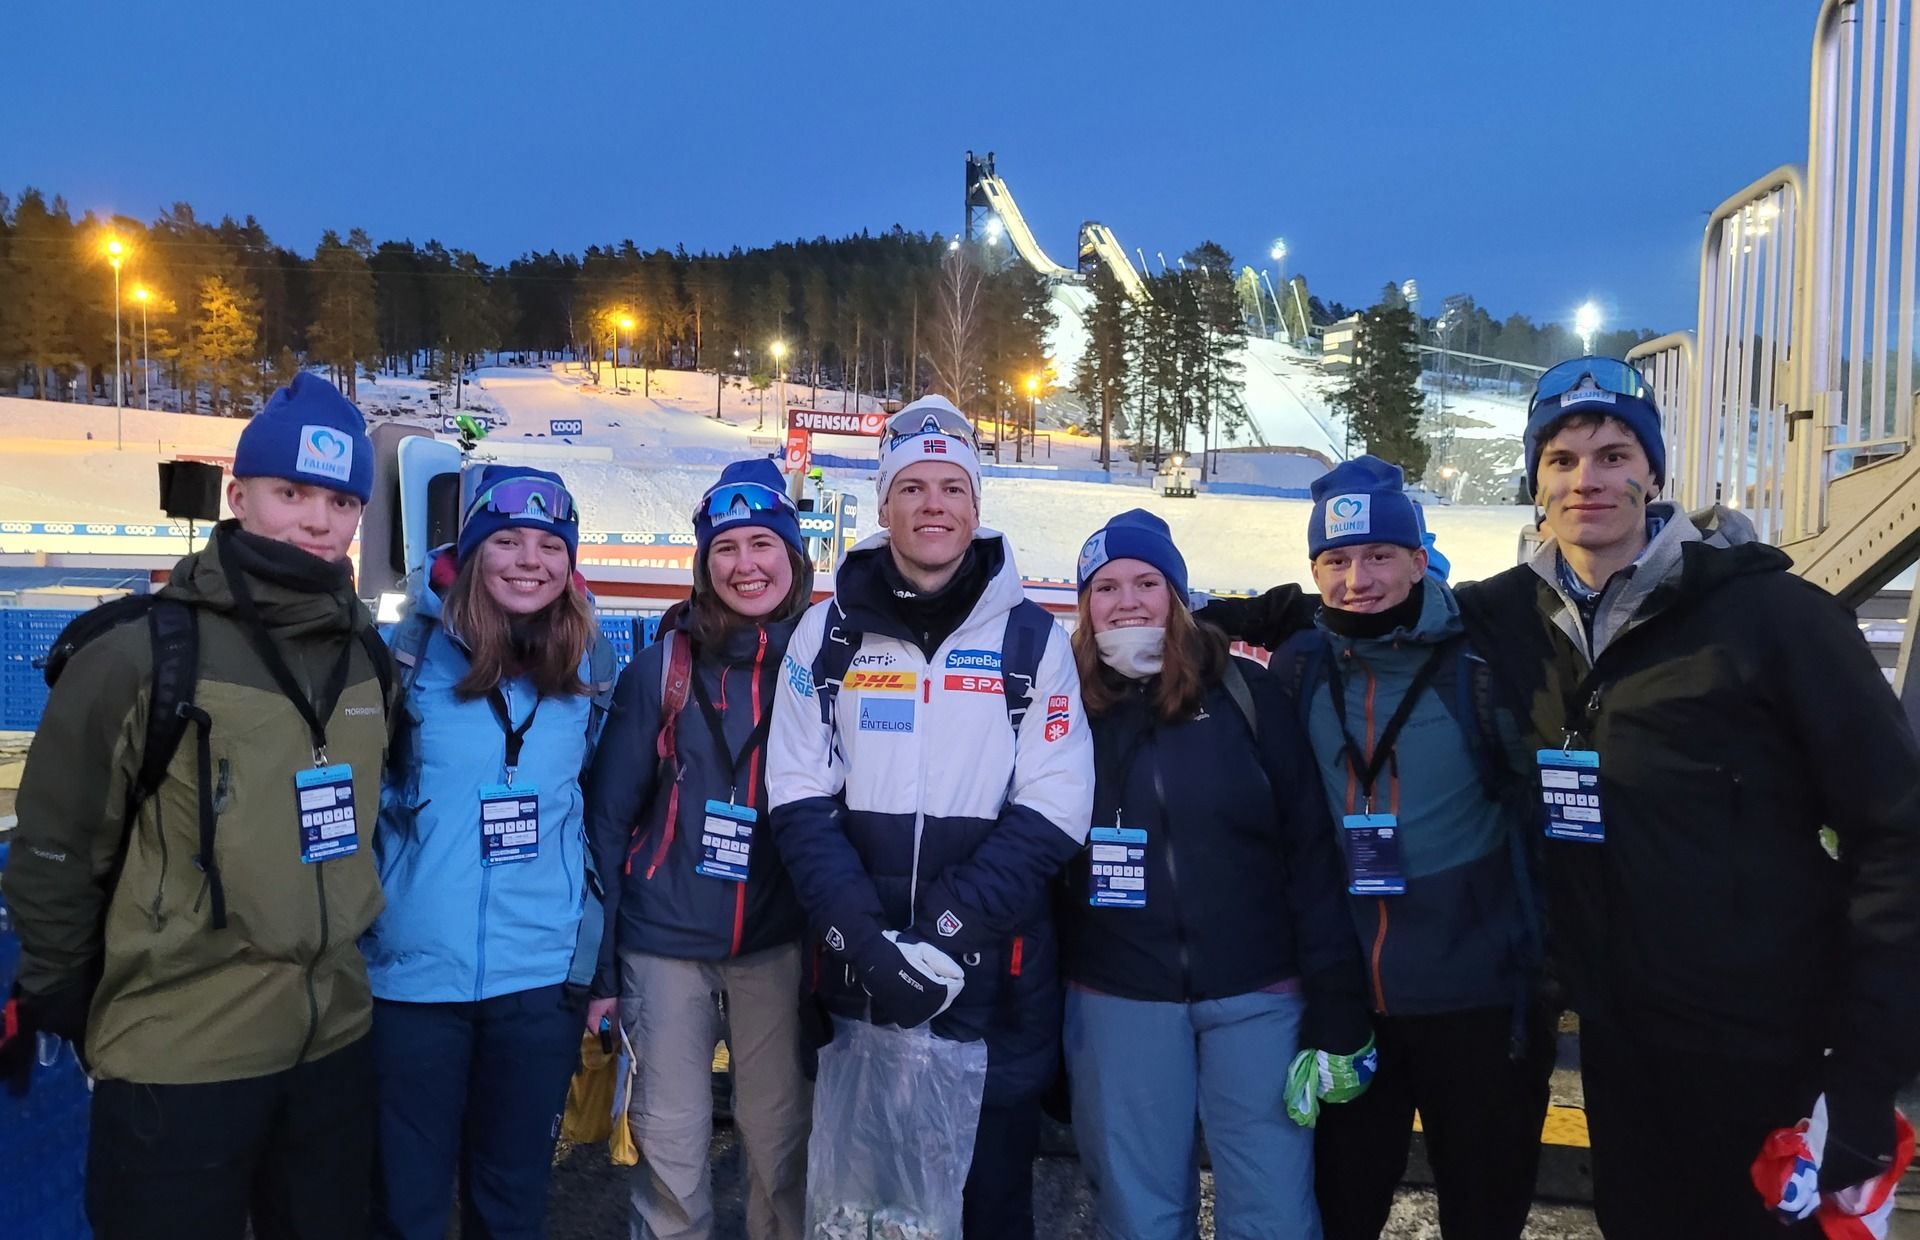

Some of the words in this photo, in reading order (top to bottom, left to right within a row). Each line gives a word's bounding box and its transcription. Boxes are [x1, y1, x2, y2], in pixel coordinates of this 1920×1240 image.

[551, 421, 581, 433] coop
[795, 413, 860, 432] SVENSKA
[1, 523, 32, 534] coop
[44, 523, 75, 535] coop
[86, 524, 117, 536] coop
[125, 525, 156, 537] coop
[1330, 521, 1356, 534] FALUN
[621, 533, 656, 546] coop
[853, 674, 904, 689] DHL
[962, 678, 1004, 693] SPA
[1050, 697, 1067, 707] NOR
[862, 707, 870, 719] Å
[861, 720, 912, 731] ENTELIOS
[898, 969, 924, 993] HESTRA
